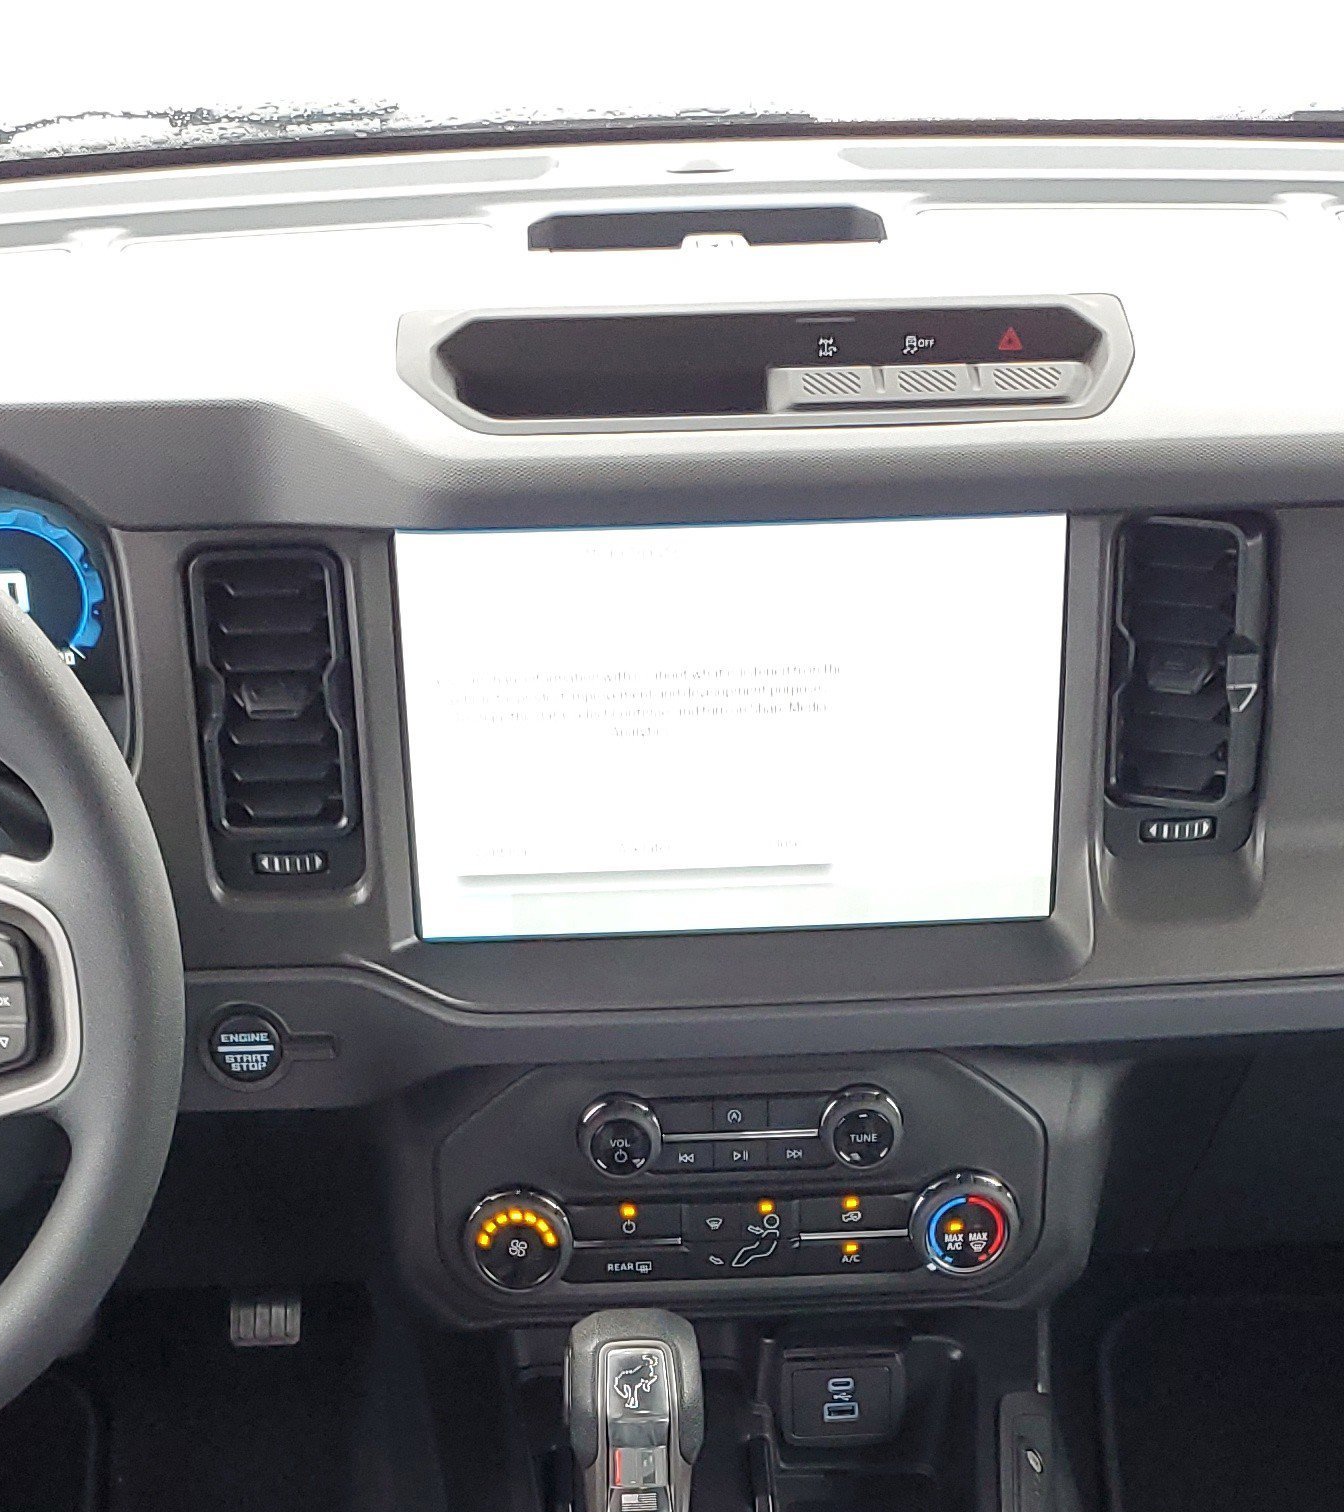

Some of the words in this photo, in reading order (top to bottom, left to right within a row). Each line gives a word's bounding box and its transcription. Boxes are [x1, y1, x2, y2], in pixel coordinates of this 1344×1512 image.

[918, 338, 935, 348] OFF
[220, 1032, 270, 1043] ENGINE
[224, 1053, 270, 1063] START
[231, 1062, 267, 1072] STOP
[849, 1133, 878, 1143] TUNE
[609, 1139, 631, 1148] VOL
[944, 1233, 964, 1242] MAX
[968, 1231, 988, 1241] MAX
[946, 1242, 963, 1251] A/C
[841, 1254, 861, 1263] A/C
[607, 1262, 634, 1272] REAR
